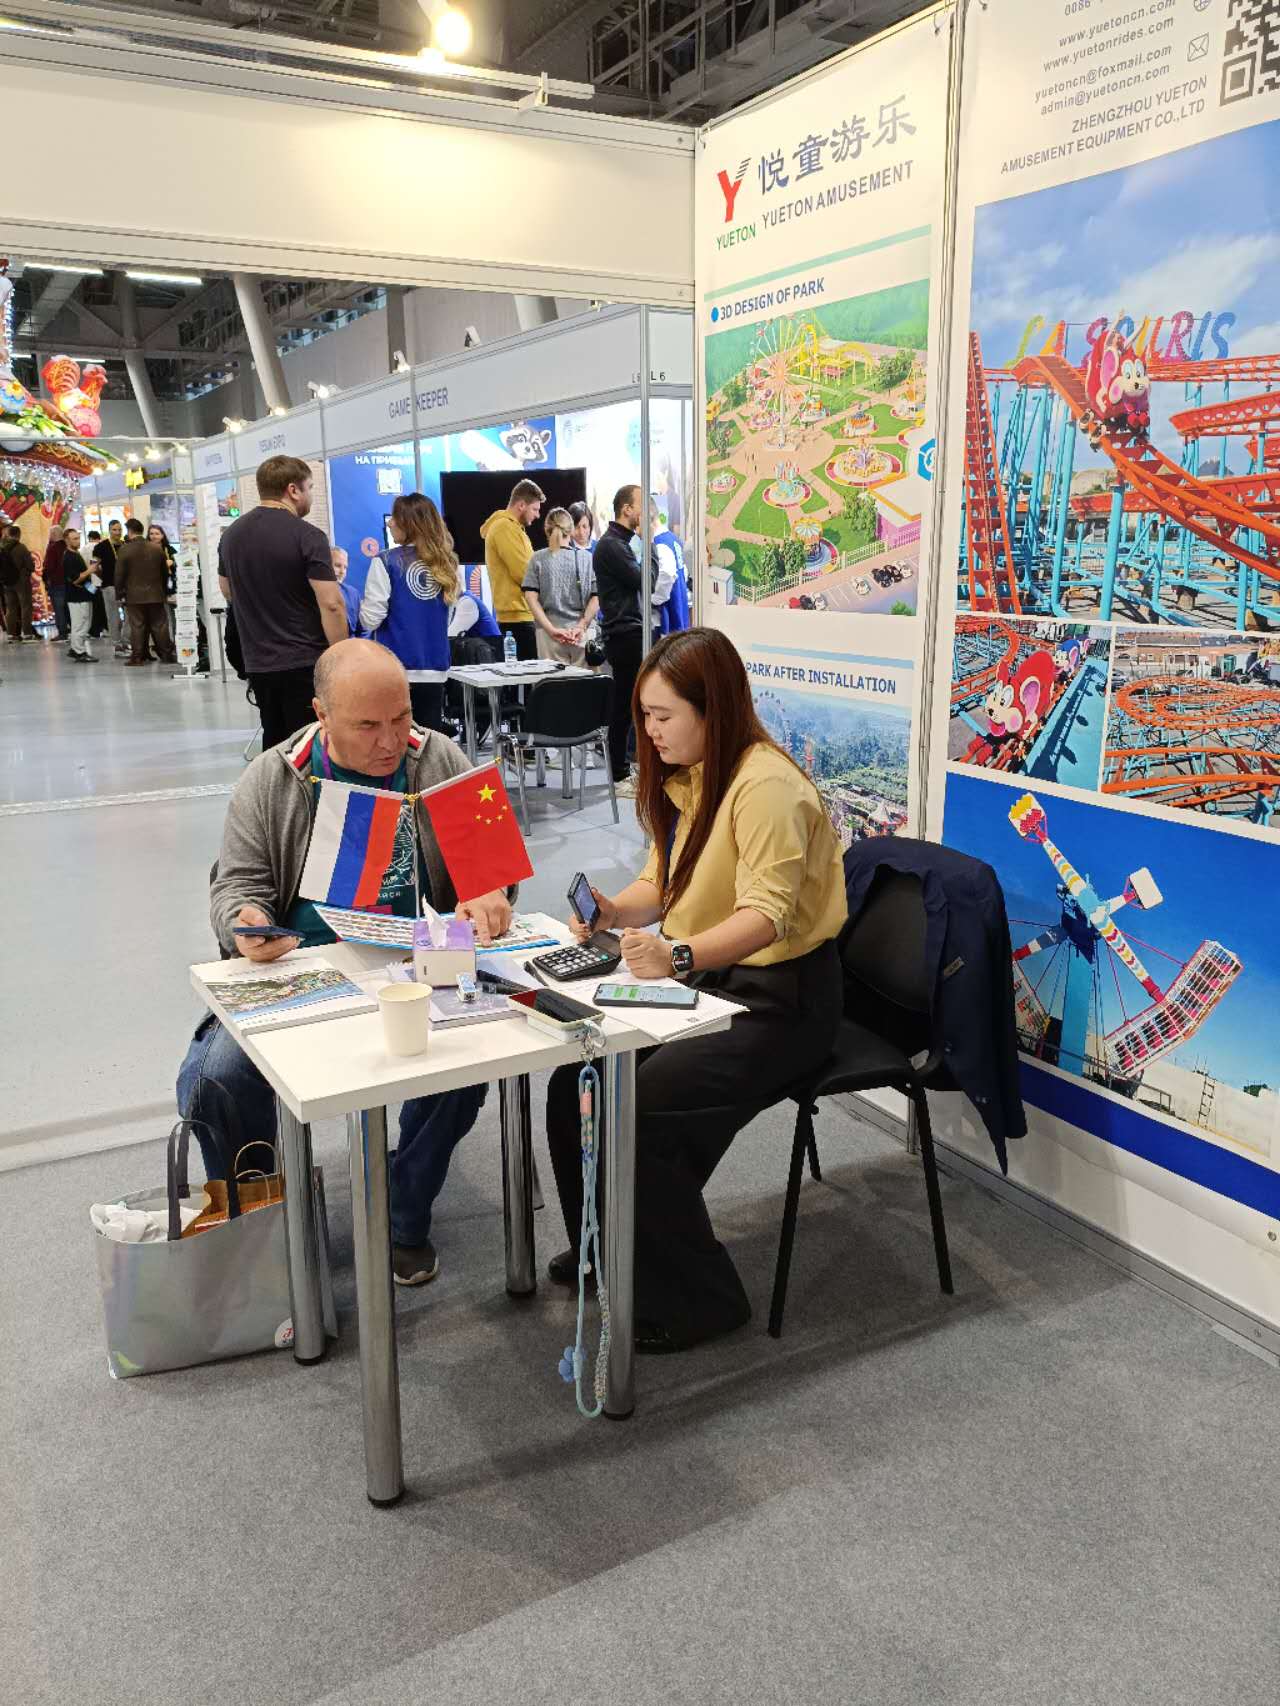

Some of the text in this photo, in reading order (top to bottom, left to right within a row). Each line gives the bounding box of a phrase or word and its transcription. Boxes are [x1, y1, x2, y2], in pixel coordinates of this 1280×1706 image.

[1043, 16, 1174, 73] www.yuetonrides.com
[1058, 0, 1176, 48] www.yuetoncn.com
[1035, 44, 1172, 103] yuetoncn@foxmail.com
[1040, 64, 1170, 116] admin@yuetoncn.com
[1072, 76, 1208, 133] ZHENGZHOU YUETON
[758, 95, 917, 195] 悦童游乐
[1001, 98, 1205, 174] AMUSEMENT EQUIPMENT CO.,LTD
[762, 160, 914, 230] YUETON AMUSEMENT
[716, 223, 757, 251] YUETON
[720, 277, 825, 321] 3D DESIGN OF PARK
[389, 387, 448, 419] GAME KEEPER
[745, 662, 896, 694] PARK AFTER INSTALLATION
